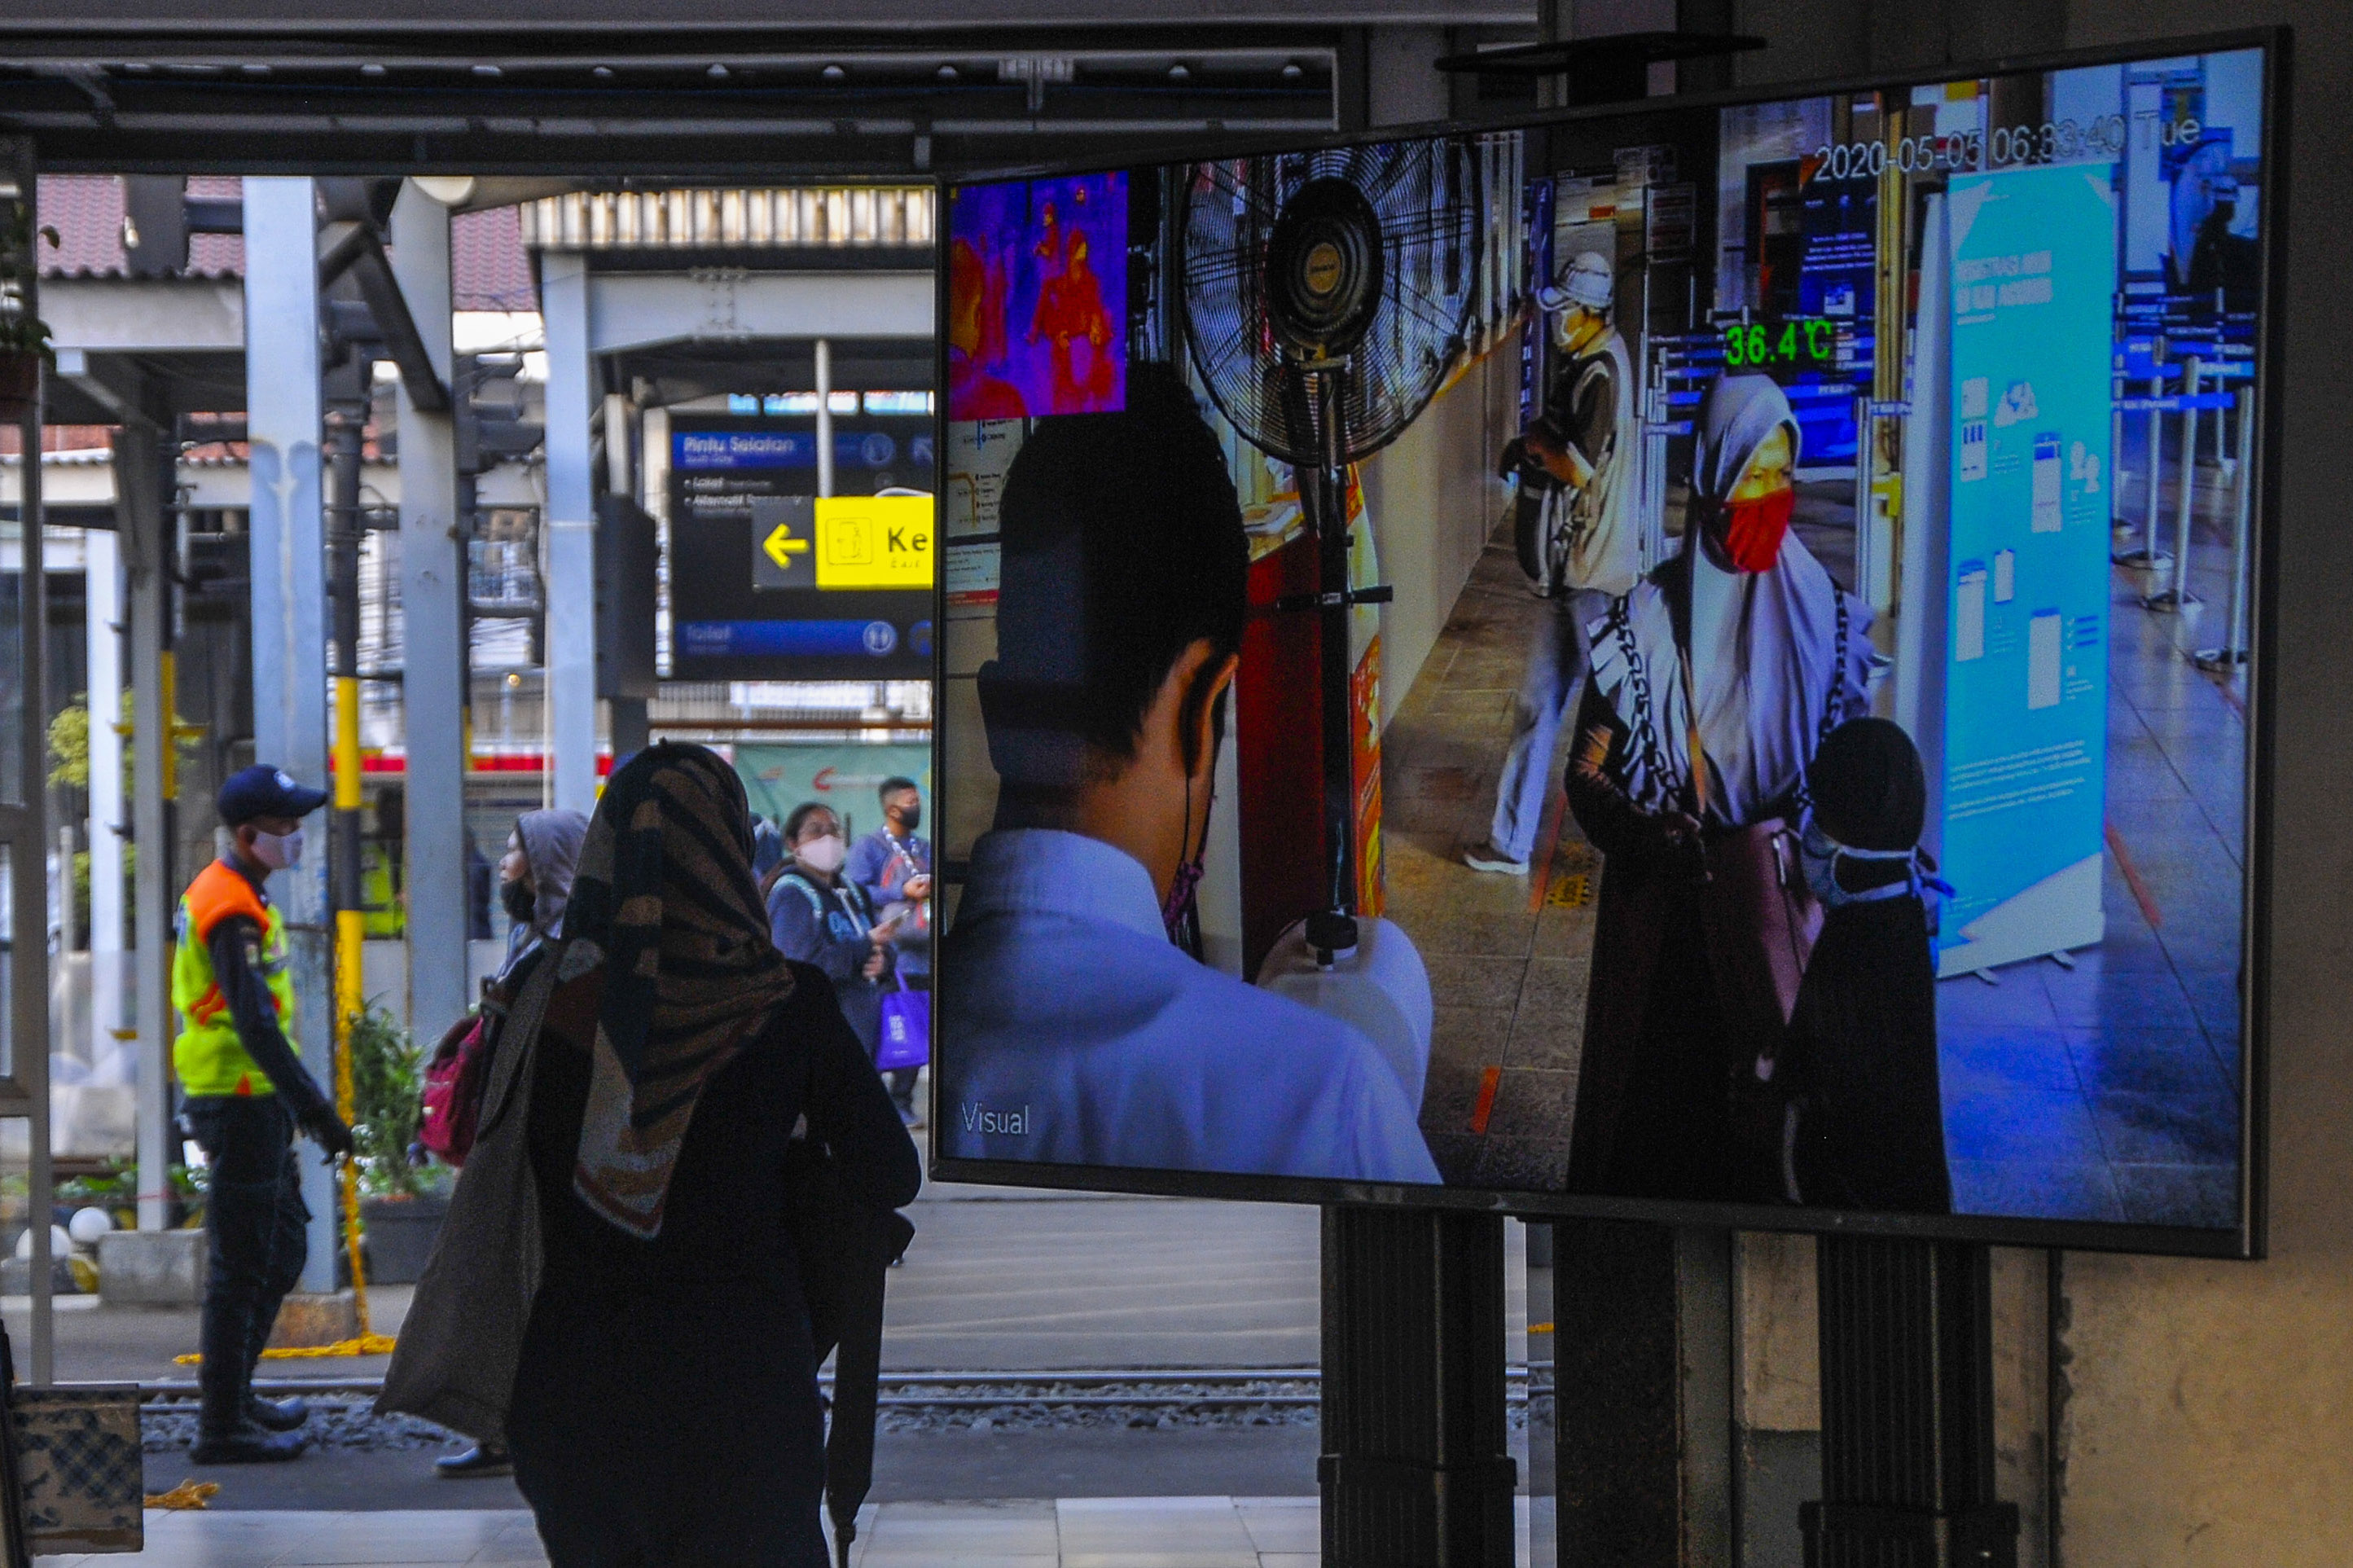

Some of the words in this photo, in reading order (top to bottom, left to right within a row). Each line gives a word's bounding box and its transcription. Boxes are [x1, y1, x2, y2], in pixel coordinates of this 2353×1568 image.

[1814, 127, 1982, 182] 2020-05-05
[1992, 112, 2125, 164] 06:33:40
[2134, 109, 2200, 151] Tue
[961, 1101, 1029, 1135] Visual
